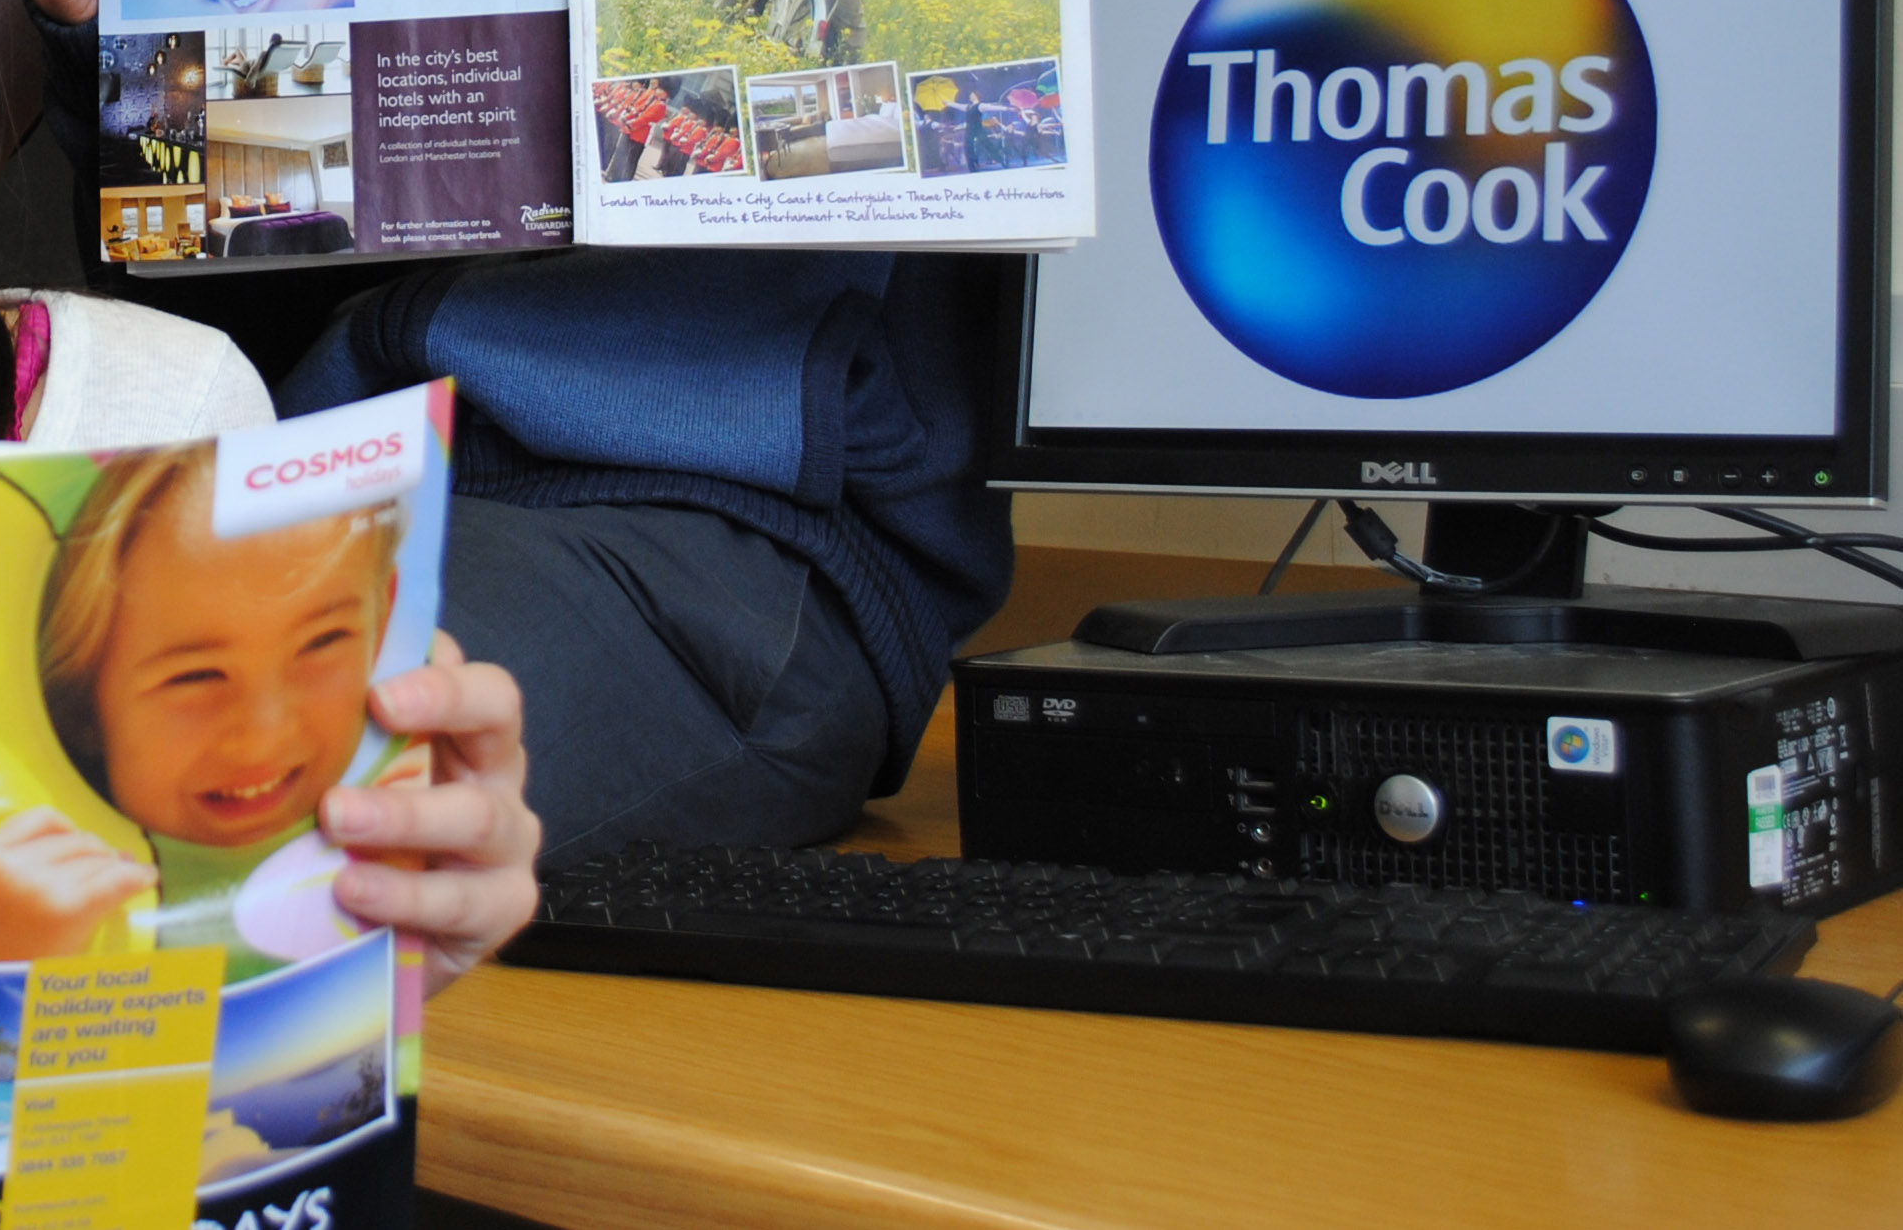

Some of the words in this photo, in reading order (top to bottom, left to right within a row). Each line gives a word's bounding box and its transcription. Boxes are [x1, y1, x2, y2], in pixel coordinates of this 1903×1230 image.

[377, 53, 390, 67] In
[395, 52, 420, 67] the
[425, 49, 461, 68] city's
[466, 48, 499, 63] best
[378, 71, 447, 87] locations,
[451, 66, 521, 84] individual
[378, 91, 424, 107] hotels
[428, 89, 461, 105] with
[467, 92, 484, 103] an
[1188, 49, 1613, 145] Thomas
[379, 110, 473, 130] independent
[478, 106, 516, 126] spirit
[600, 195, 638, 207] London
[642, 195, 688, 206] Theatre
[690, 193, 733, 206] Breaks
[777, 192, 813, 204] Coast
[827, 191, 894, 207] Countryside
[906, 191, 942, 202] Theme
[944, 189, 981, 201] Parks
[996, 188, 1065, 200] Attractions
[1340, 143, 1609, 247] Cook
[520, 202, 572, 223] Radisson
[699, 211, 738, 224] Events
[753, 210, 834, 223] Entertainment
[920, 207, 964, 220] Breaks
[381, 222, 395, 230] For
[381, 234, 401, 243] book
[458, 231, 501, 241] Superbreak
[245, 432, 403, 490] COSMOS
[1361, 461, 1437, 484] DELL
[1042, 698, 1076, 709] DVD
[39, 974, 89, 992] Your
[96, 966, 150, 987] local
[34, 994, 114, 1019] holiday
[122, 987, 206, 1011] experts
[32, 1026, 68, 1042] are
[75, 1016, 156, 1038] waiting
[28, 1048, 59, 1067] for
[66, 1048, 106, 1066] you
